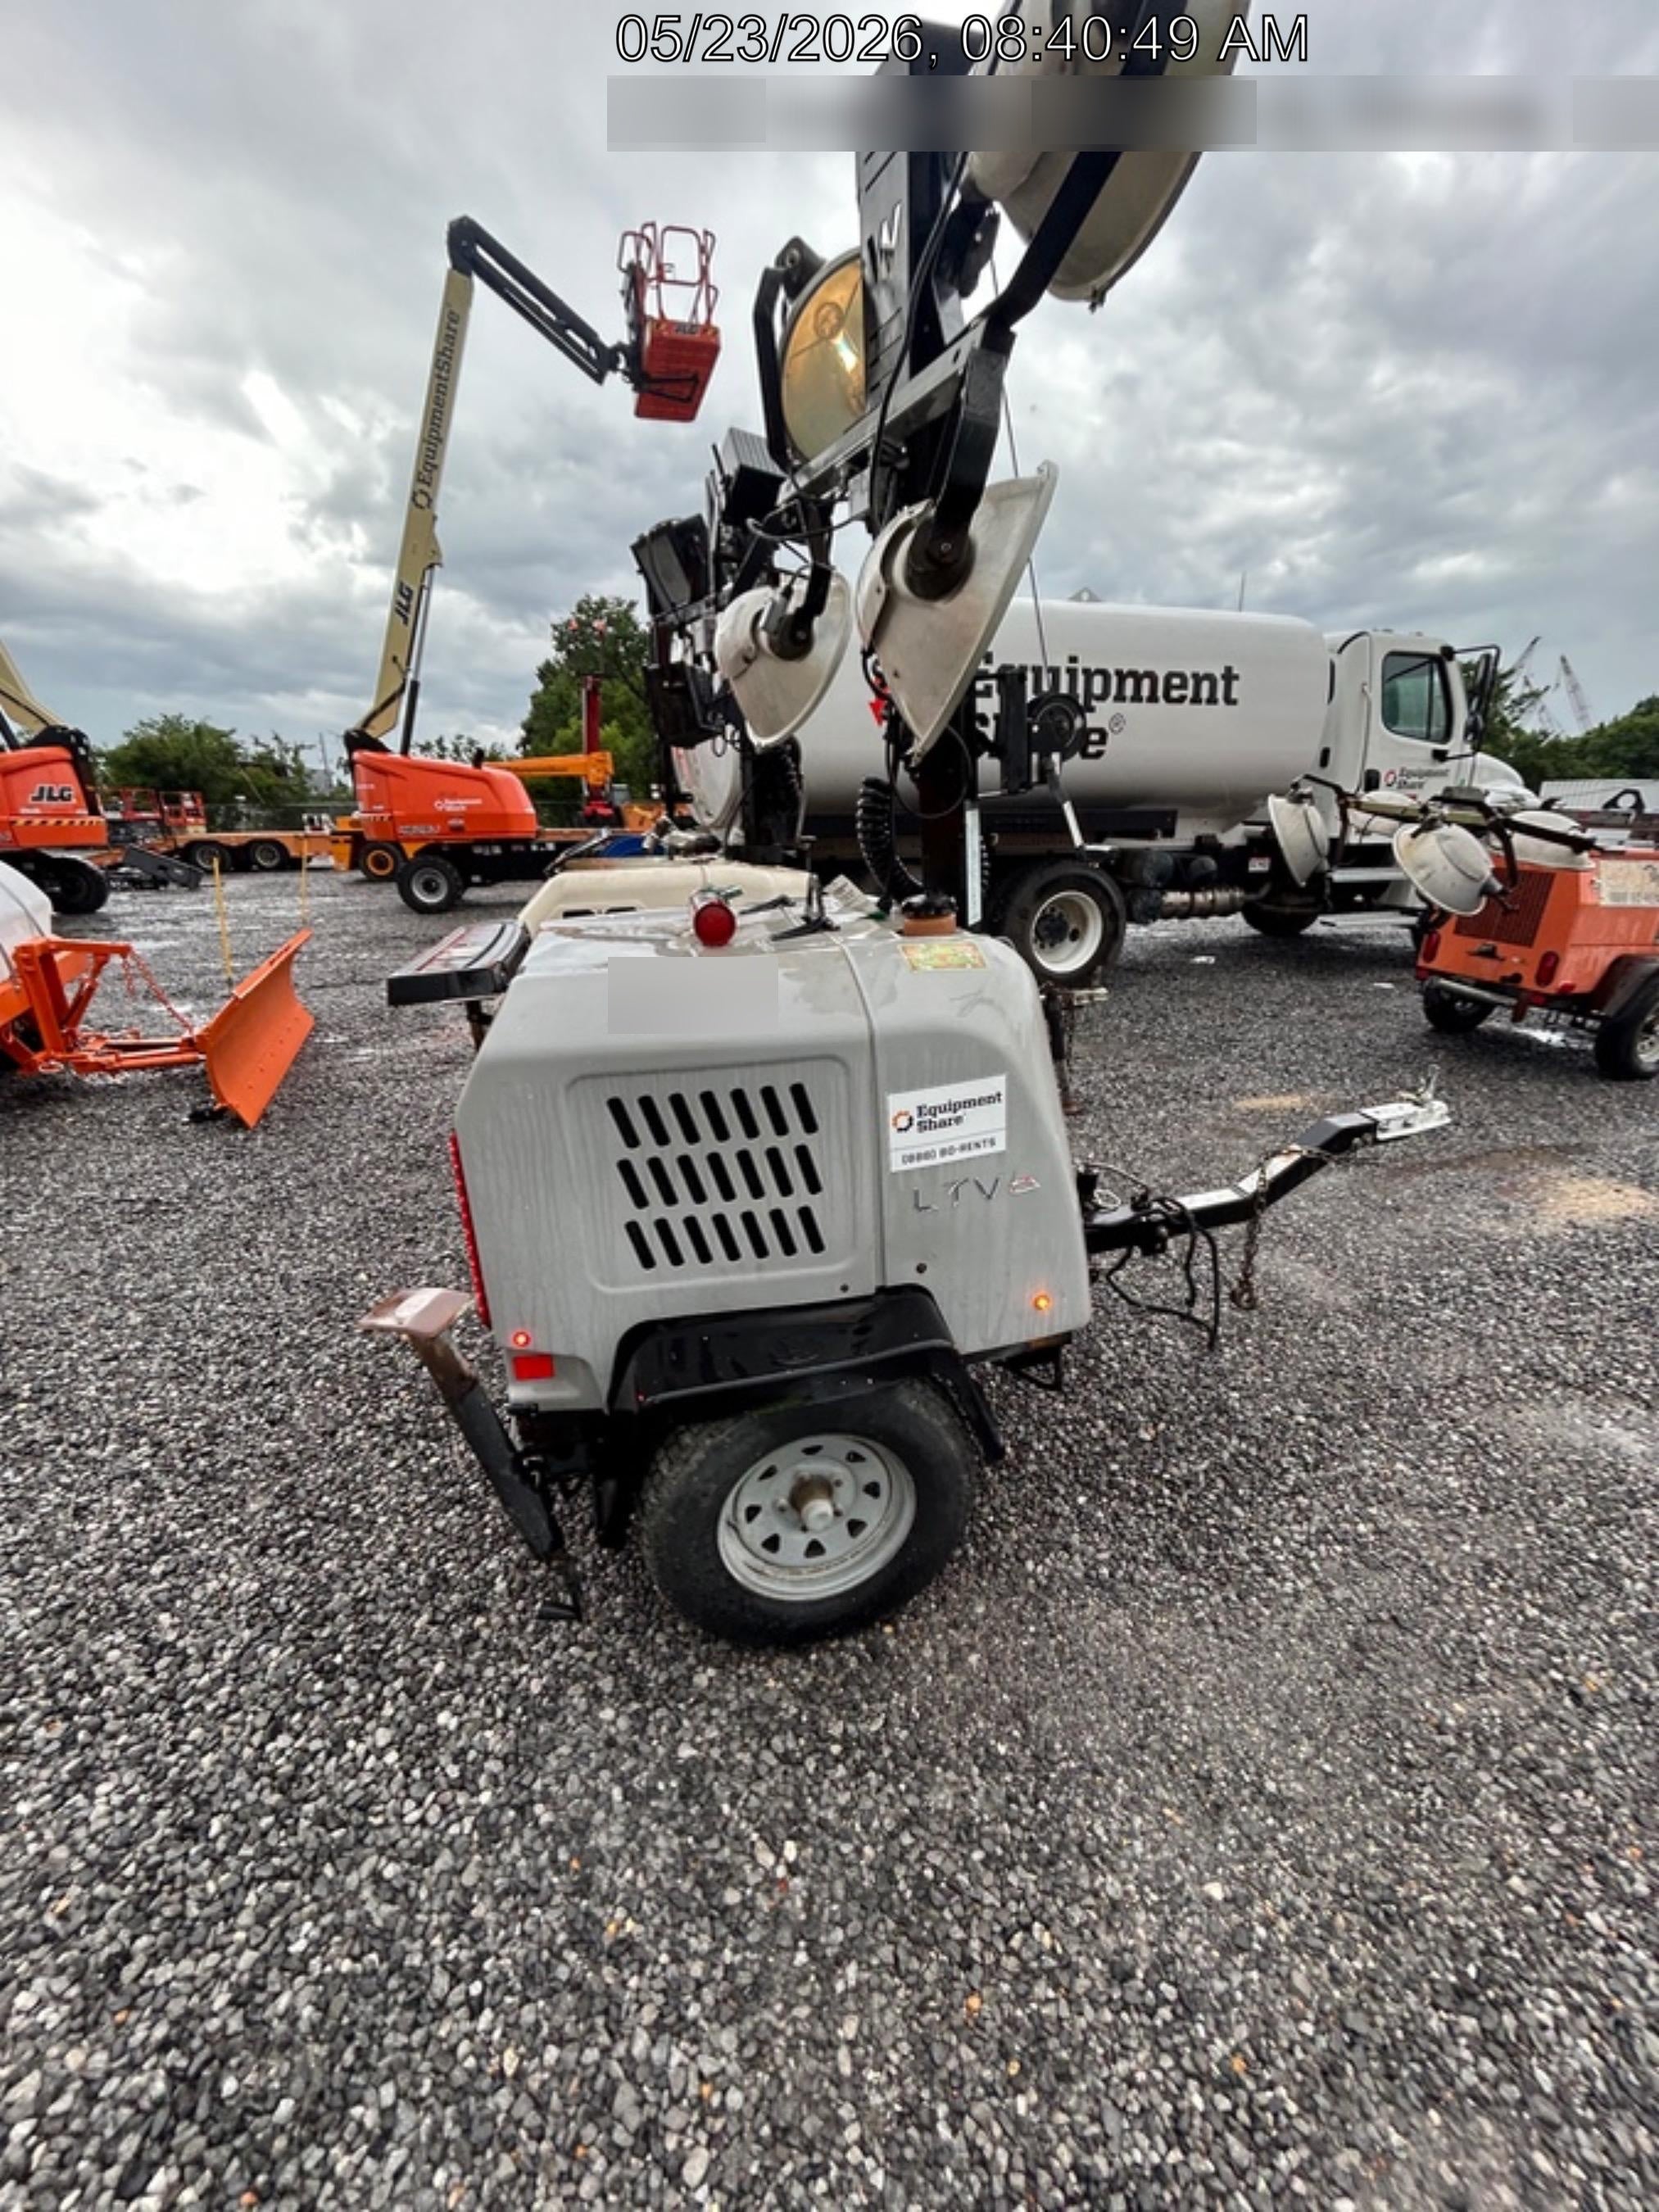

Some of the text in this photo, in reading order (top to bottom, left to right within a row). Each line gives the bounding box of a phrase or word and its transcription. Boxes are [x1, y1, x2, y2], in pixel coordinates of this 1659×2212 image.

[417, 310, 460, 487] EquipmentShare
[395, 580, 413, 628] JLG
[31, 785, 73, 802] JLG
[916, 1091, 1002, 1118] Equipment
[917, 1114, 963, 1133] Share
